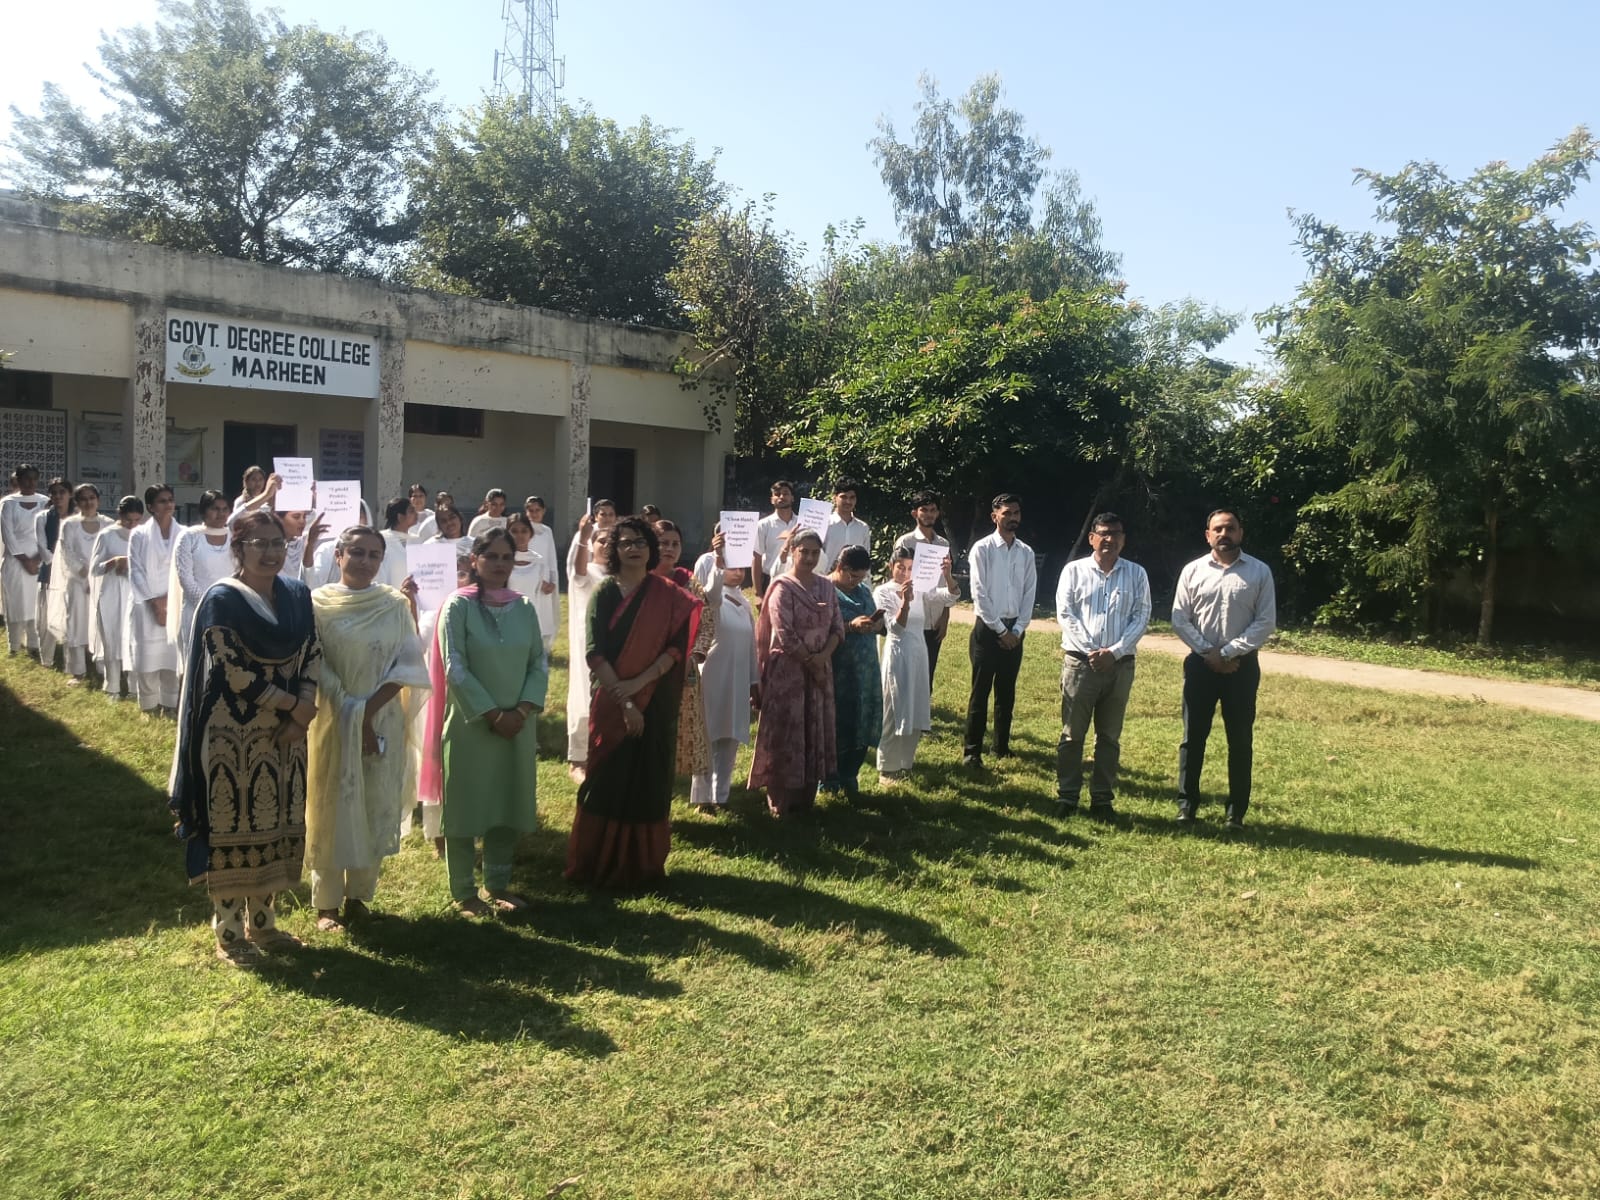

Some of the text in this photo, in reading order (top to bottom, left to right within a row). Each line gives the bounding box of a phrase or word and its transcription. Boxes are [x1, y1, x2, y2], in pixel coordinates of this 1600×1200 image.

[168, 319, 371, 366] GOVT. DEGREE COLLEGE
[231, 355, 326, 386] MARHEEN
